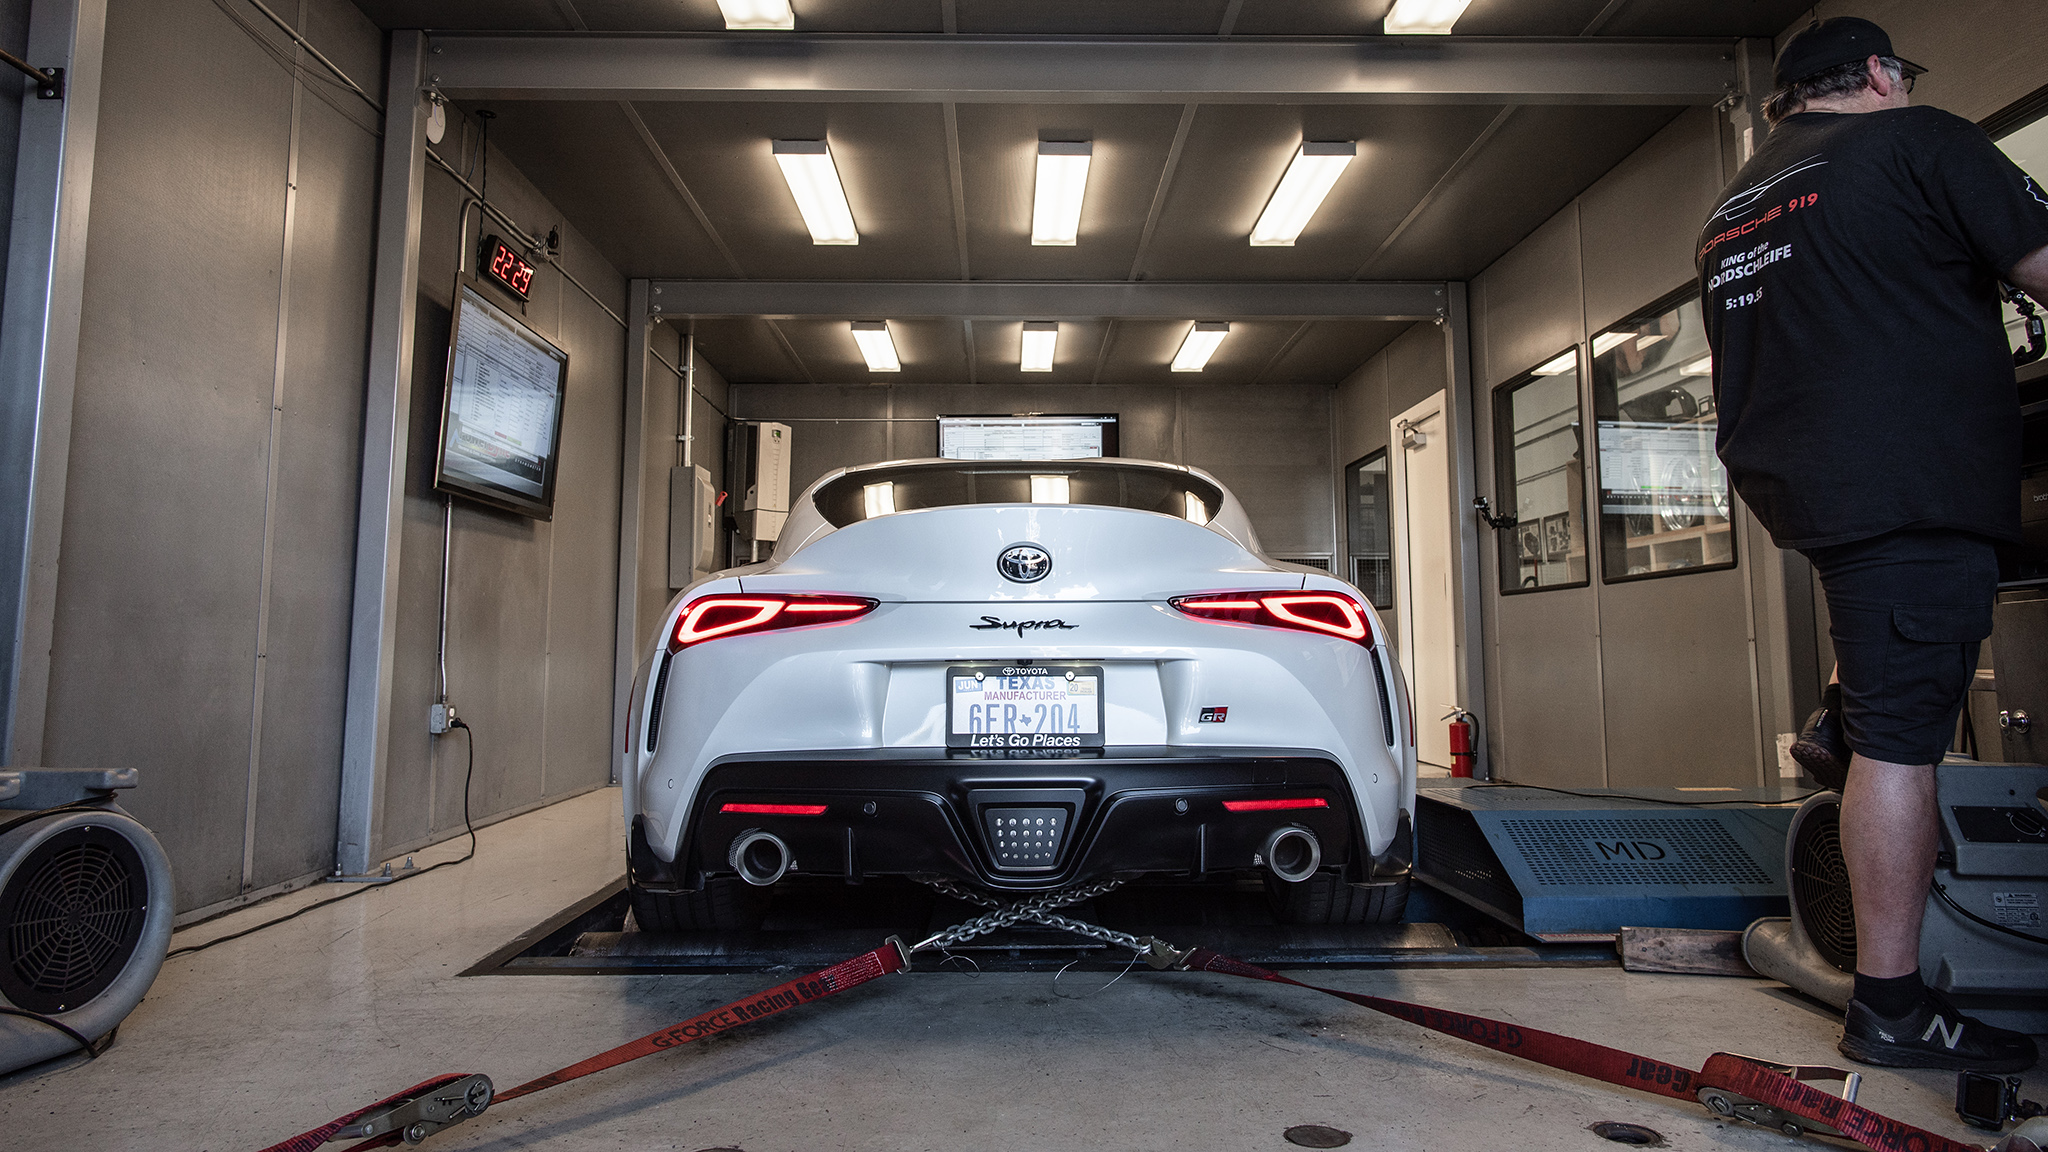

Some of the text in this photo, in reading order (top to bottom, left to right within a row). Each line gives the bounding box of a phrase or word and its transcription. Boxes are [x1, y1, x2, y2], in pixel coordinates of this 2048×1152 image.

[1788, 193, 1818, 212] 919
[1720, 252, 1745, 269] KING
[1747, 247, 1757, 260] of
[1707, 244, 1792, 293] NORDSCHLEIFE
[969, 616, 1080, 639] Supra
[1015, 667, 1049, 675] TOYOTA
[957, 680, 979, 691] JUN
[996, 676, 1056, 690] TEXAS
[984, 691, 1067, 701] MANUFACTURER
[1200, 712, 1226, 722] GR
[970, 734, 1081, 747] Let's Go Places
[1594, 841, 1666, 861] MD
[652, 1011, 737, 1048] G-FORCE
[731, 985, 799, 1022] Racing
[1625, 1057, 1692, 1093] Gear
